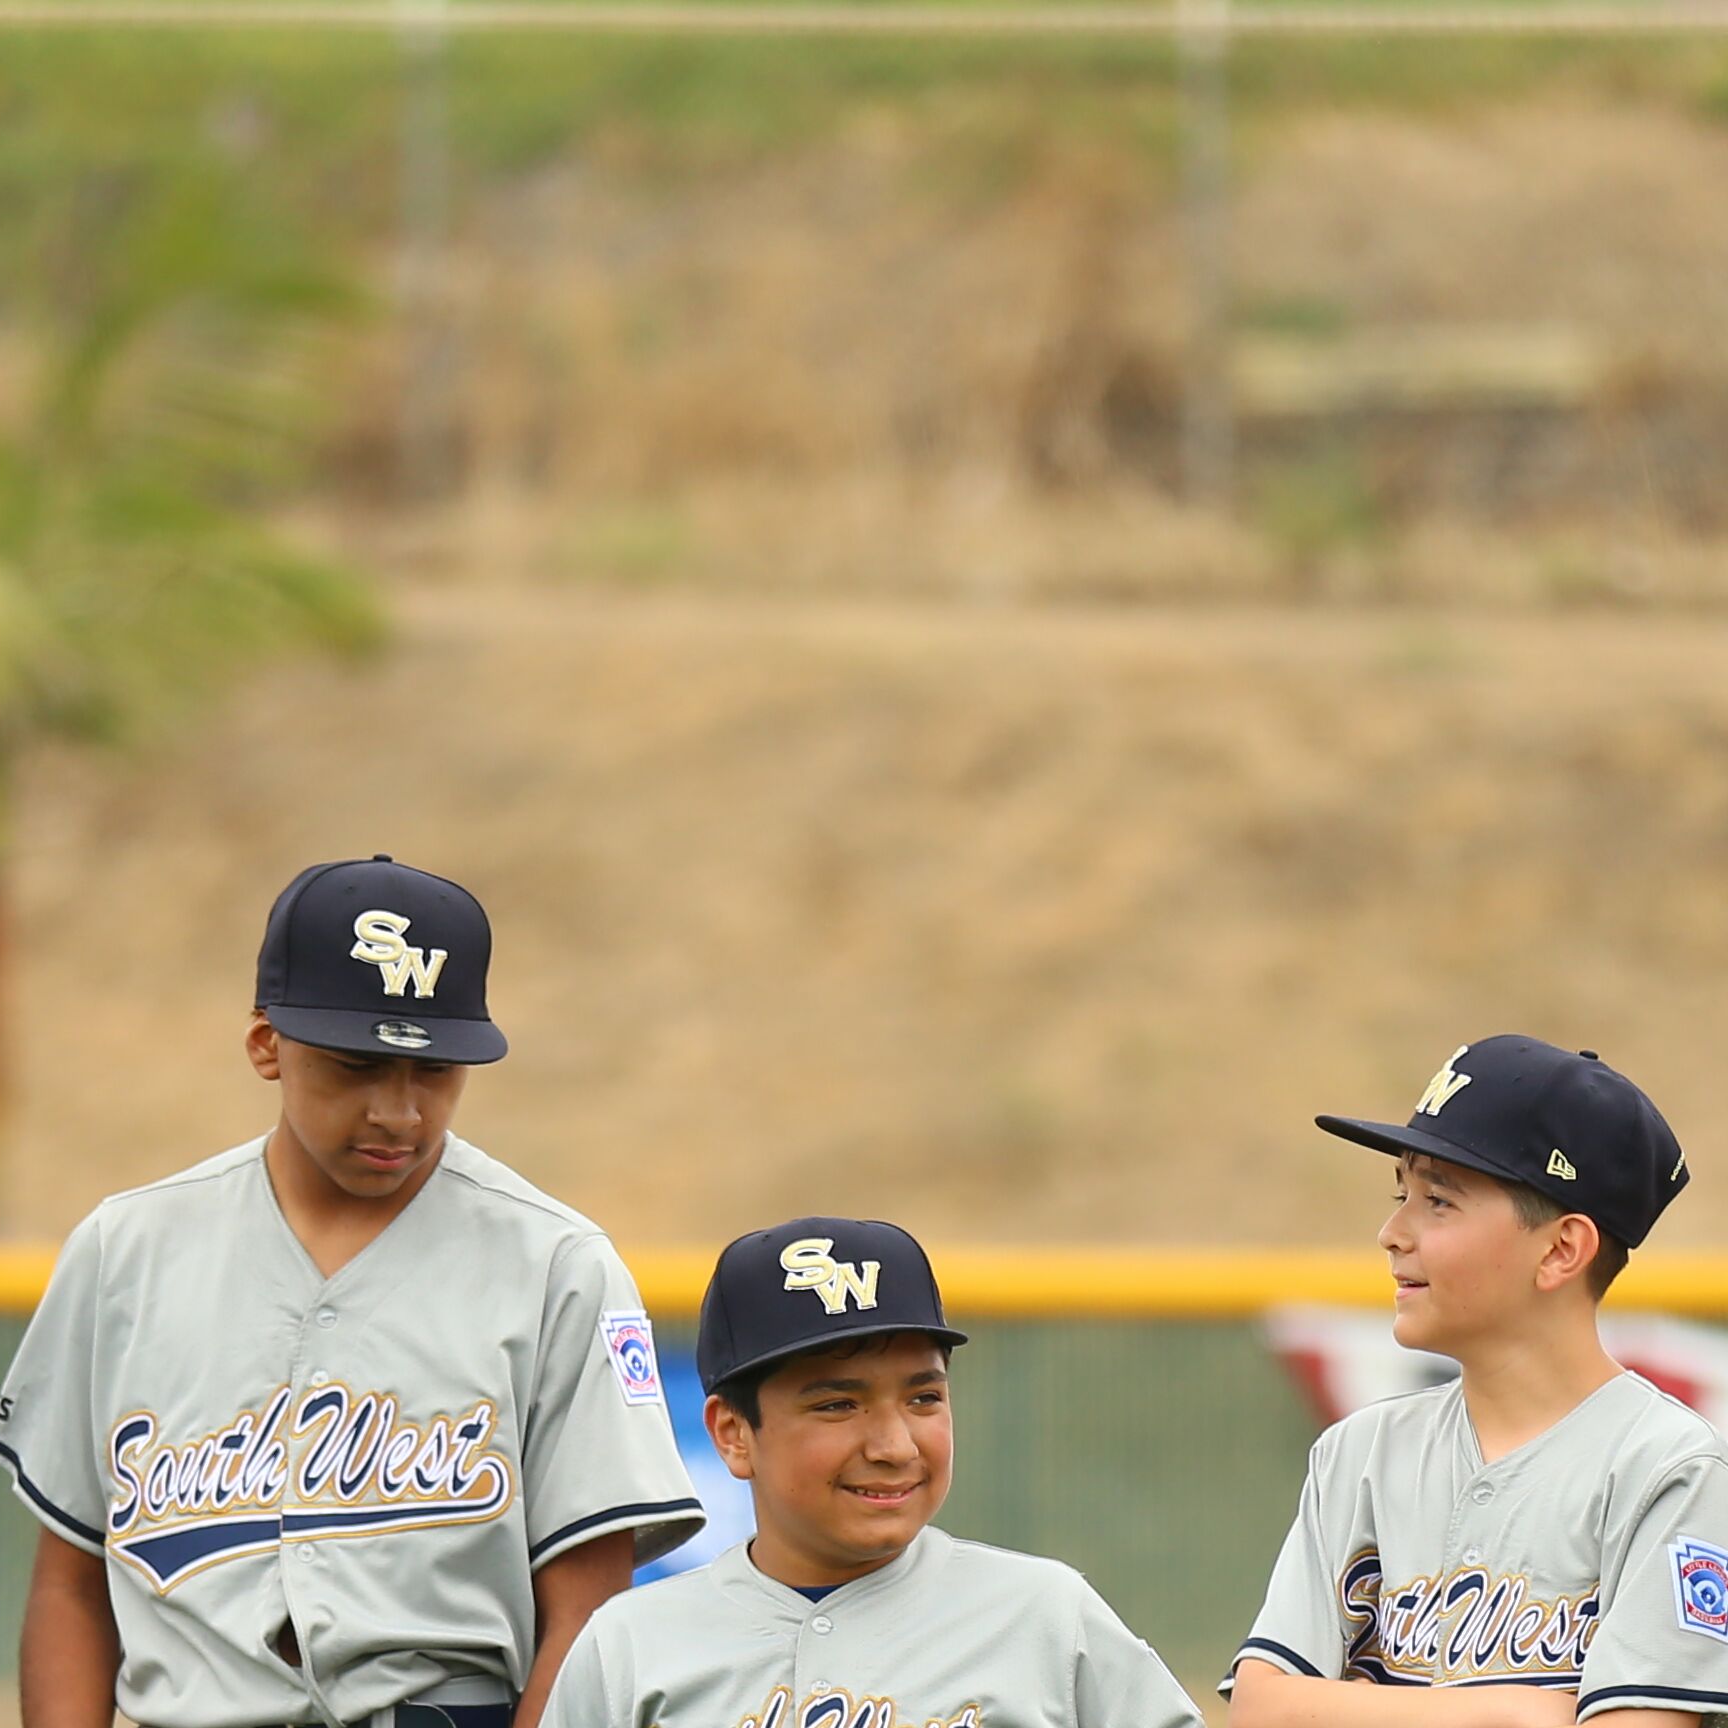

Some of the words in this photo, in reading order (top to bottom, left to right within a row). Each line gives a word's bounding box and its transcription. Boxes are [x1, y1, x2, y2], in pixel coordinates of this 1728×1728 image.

[350, 910, 448, 998] SW
[780, 1238, 881, 1314] SW
[108, 1384, 290, 1540] South
[291, 1379, 510, 1505] West
[1440, 1565, 1600, 1675] West
